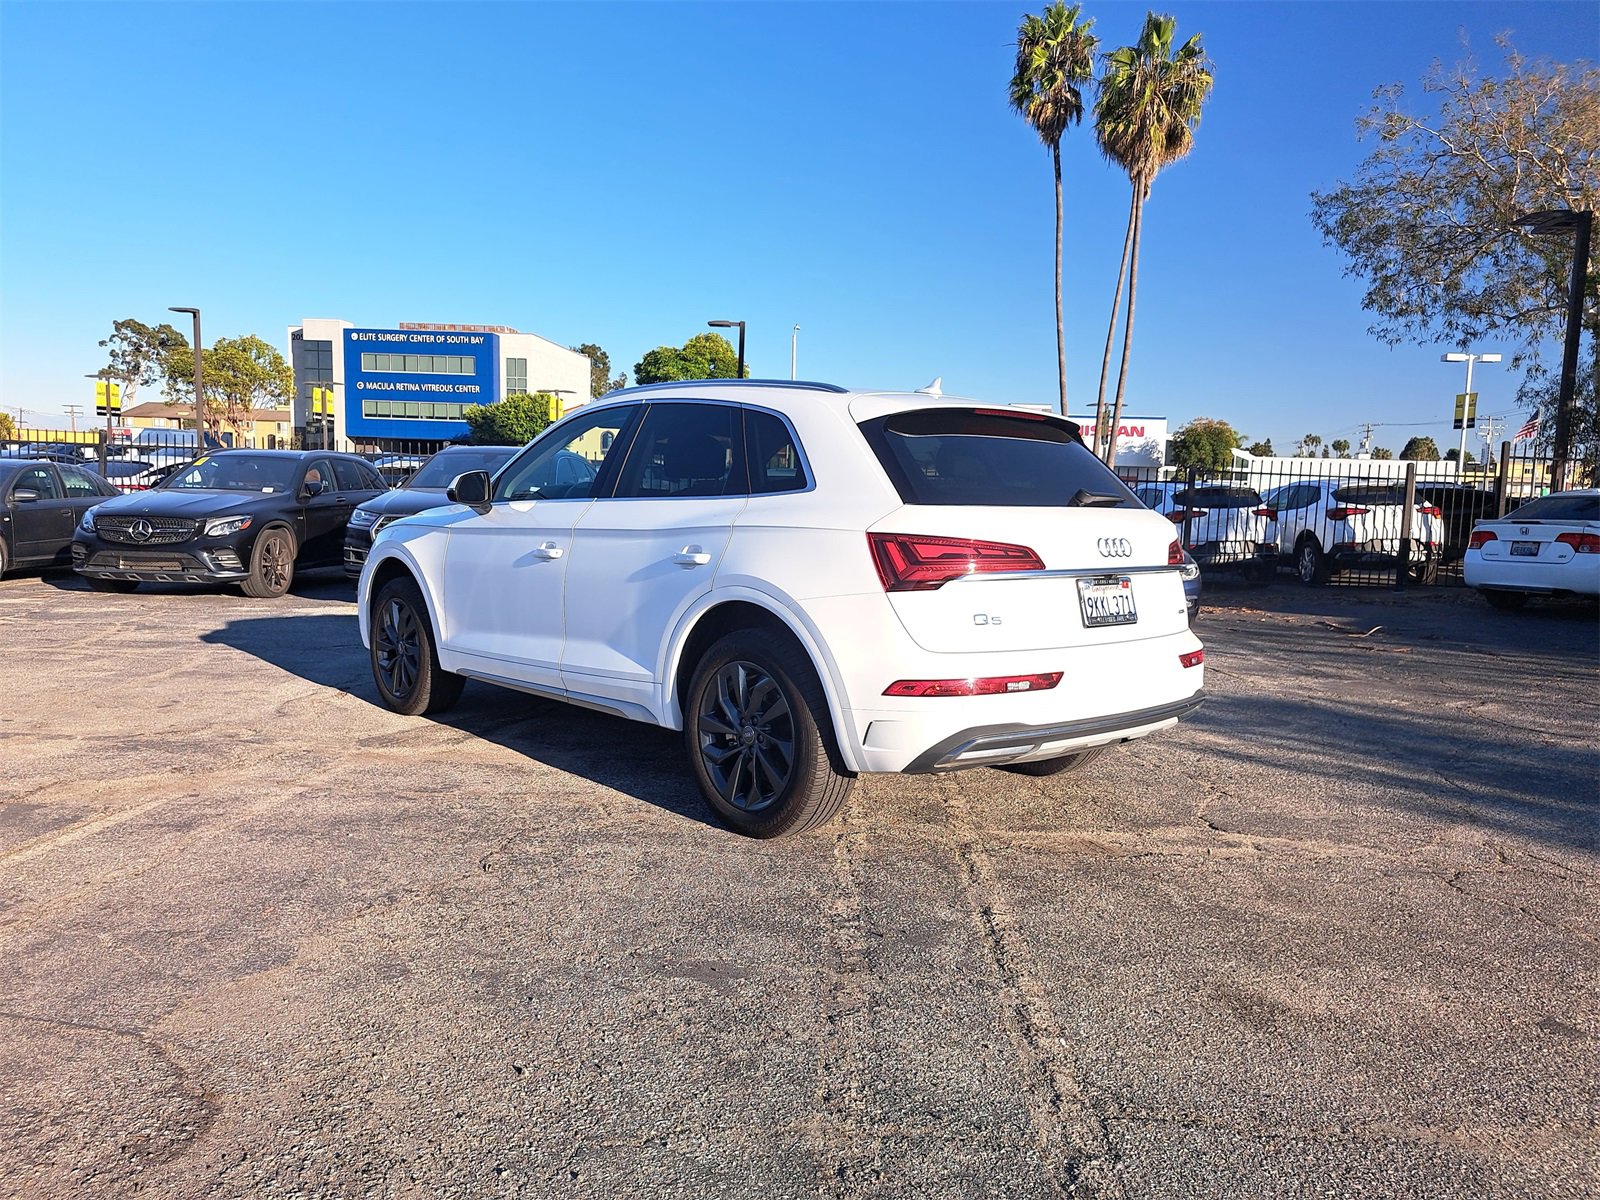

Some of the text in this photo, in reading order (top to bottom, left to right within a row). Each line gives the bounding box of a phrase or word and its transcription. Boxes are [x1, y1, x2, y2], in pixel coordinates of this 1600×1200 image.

[359, 332, 484, 344] ELITE SURGERY CENTER OF SOUTH BAY
[365, 382, 480, 393] MACULA RETINA VITREOUS CENTER
[1087, 595, 1133, 617] 9KKL371
[973, 613, 1002, 626] Q5
